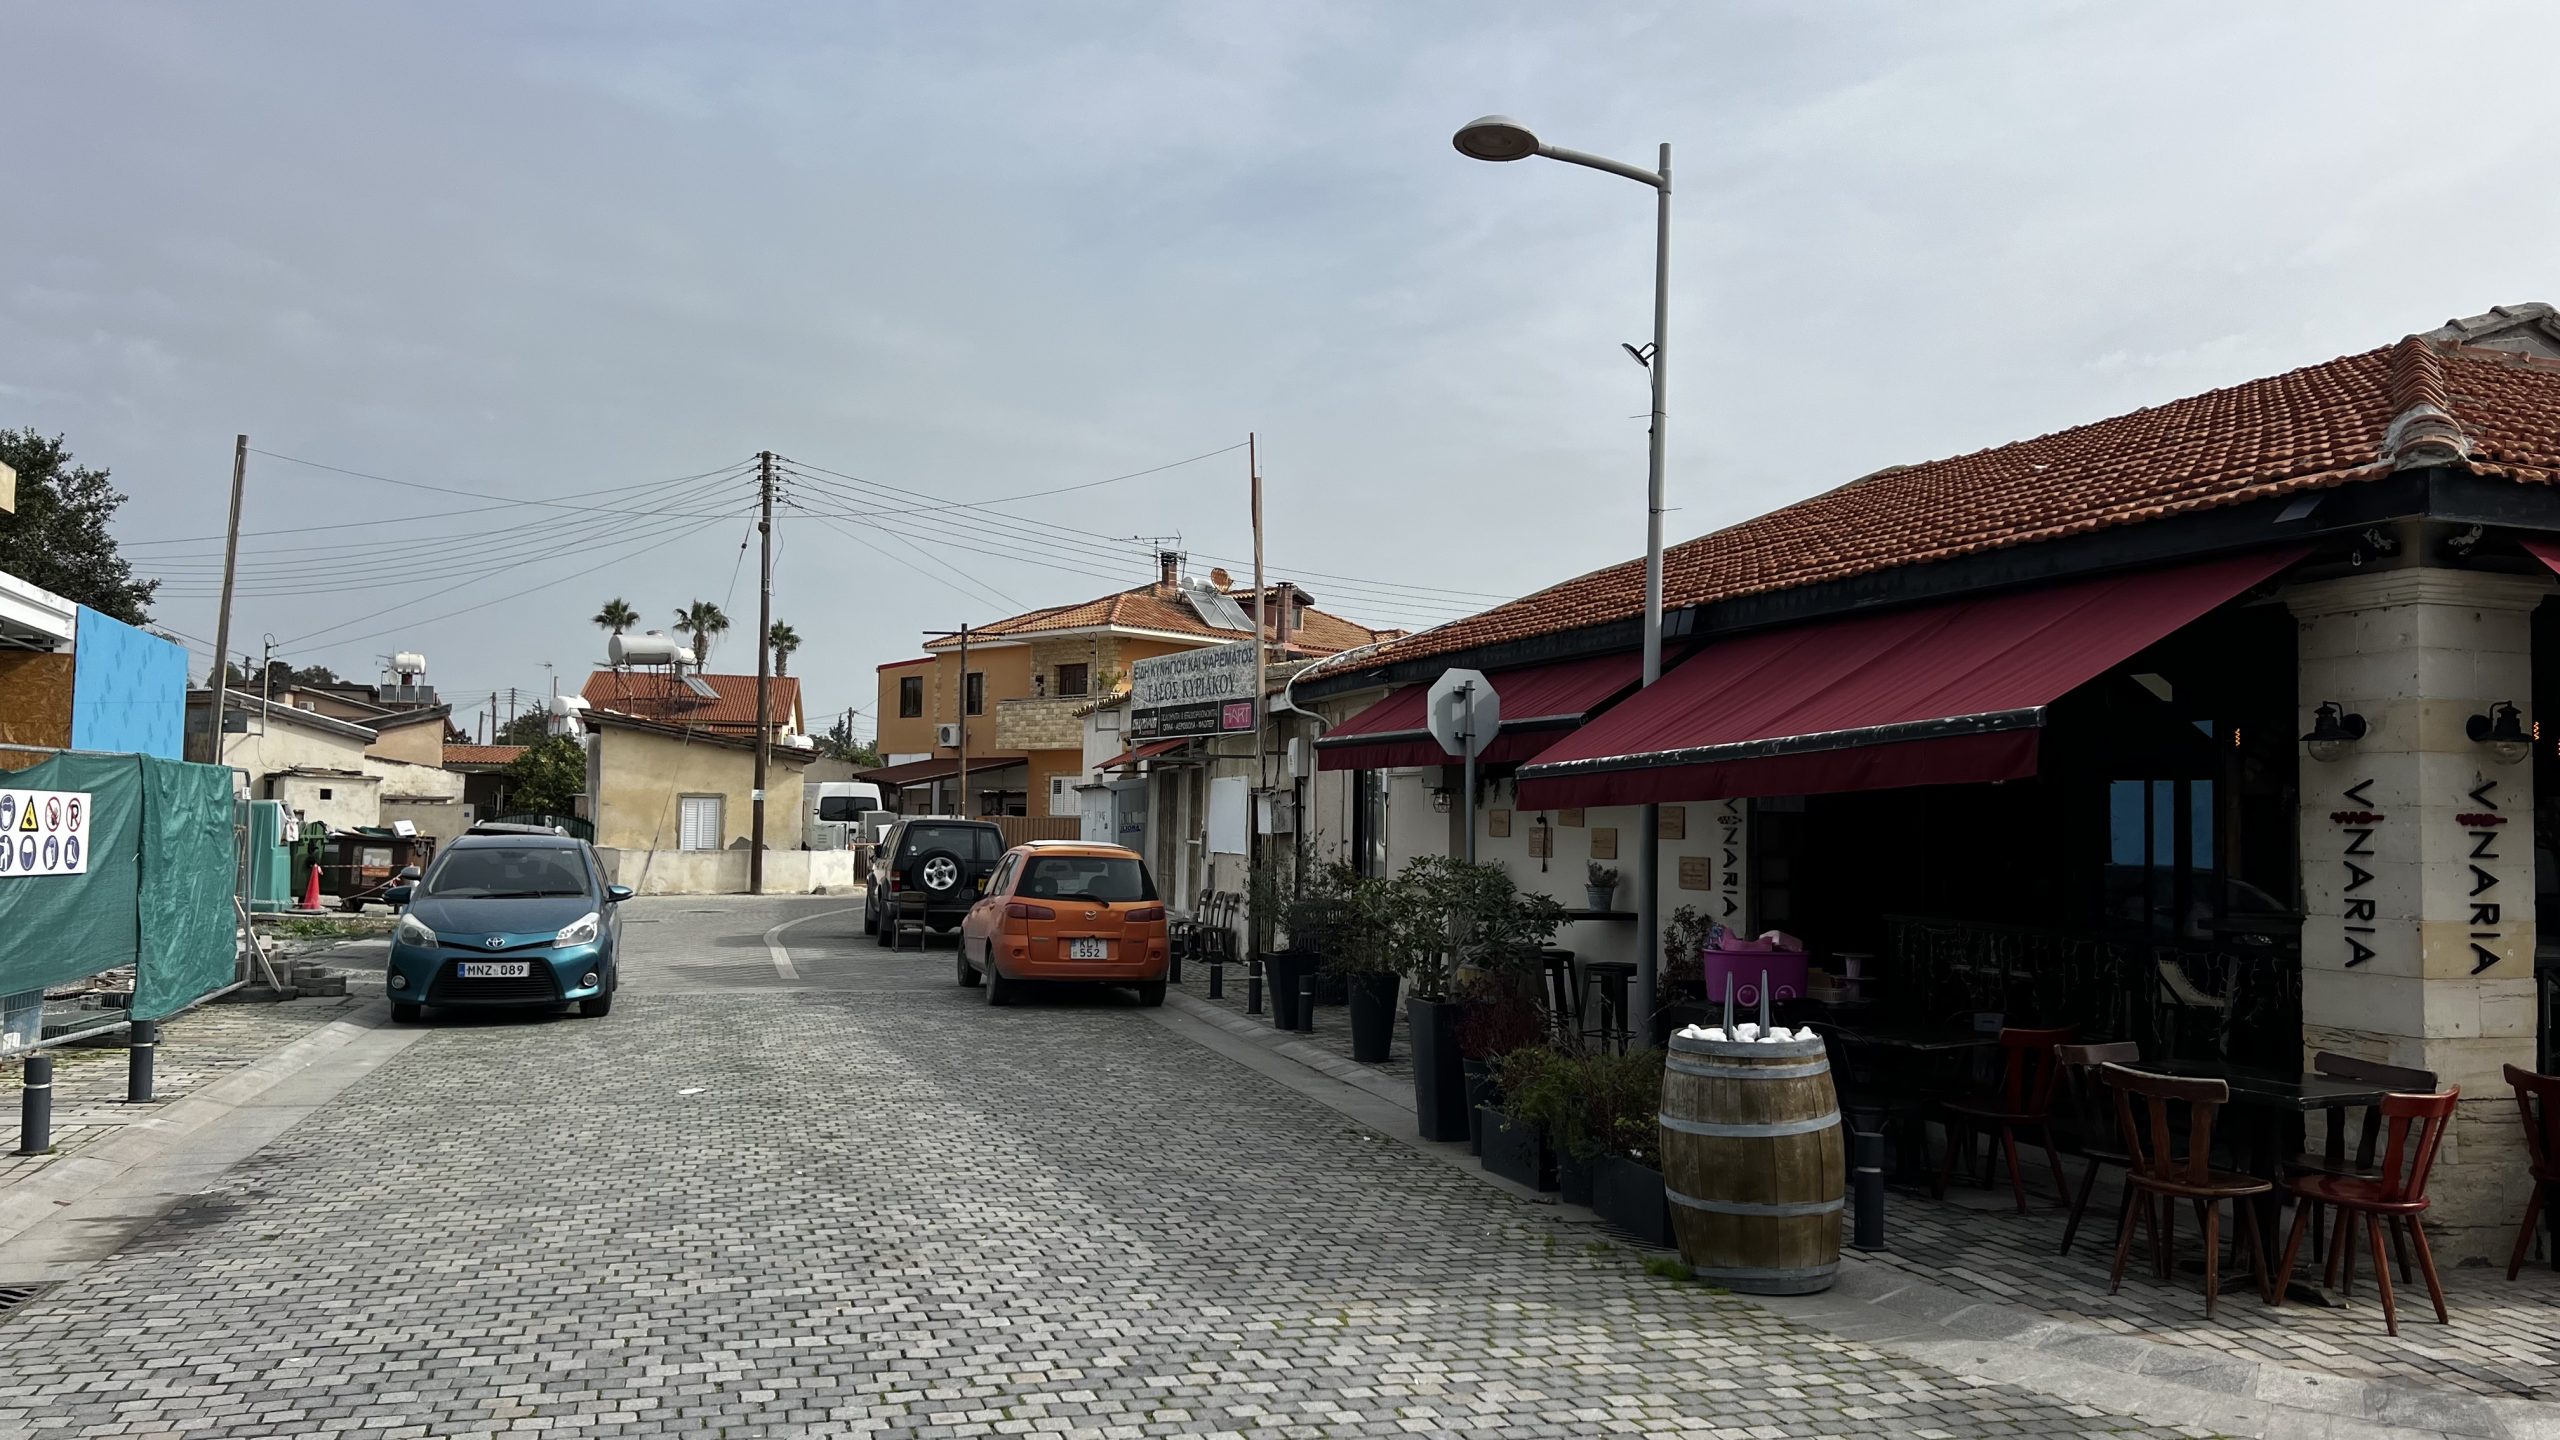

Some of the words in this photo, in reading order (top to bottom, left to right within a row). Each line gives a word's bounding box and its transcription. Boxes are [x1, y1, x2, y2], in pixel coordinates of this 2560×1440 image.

[1134, 666, 1149, 680] ΕΙΔΗ
[1150, 660, 1186, 677] ΚΥΝΗΓΙΟΥ
[1188, 656, 1200, 671] ΚΑΙ
[1202, 647, 1253, 669] ΨΑΡΕΜΑΤΟΣ
[1147, 681, 1178, 703] ΤΑΣΟΣ
[1183, 672, 1235, 698] ΚΥΡΙΑΚΟΥ
[1079, 948, 1100, 958] 552
[468, 966, 492, 975] MNZ
[501, 966, 523, 975] 089
